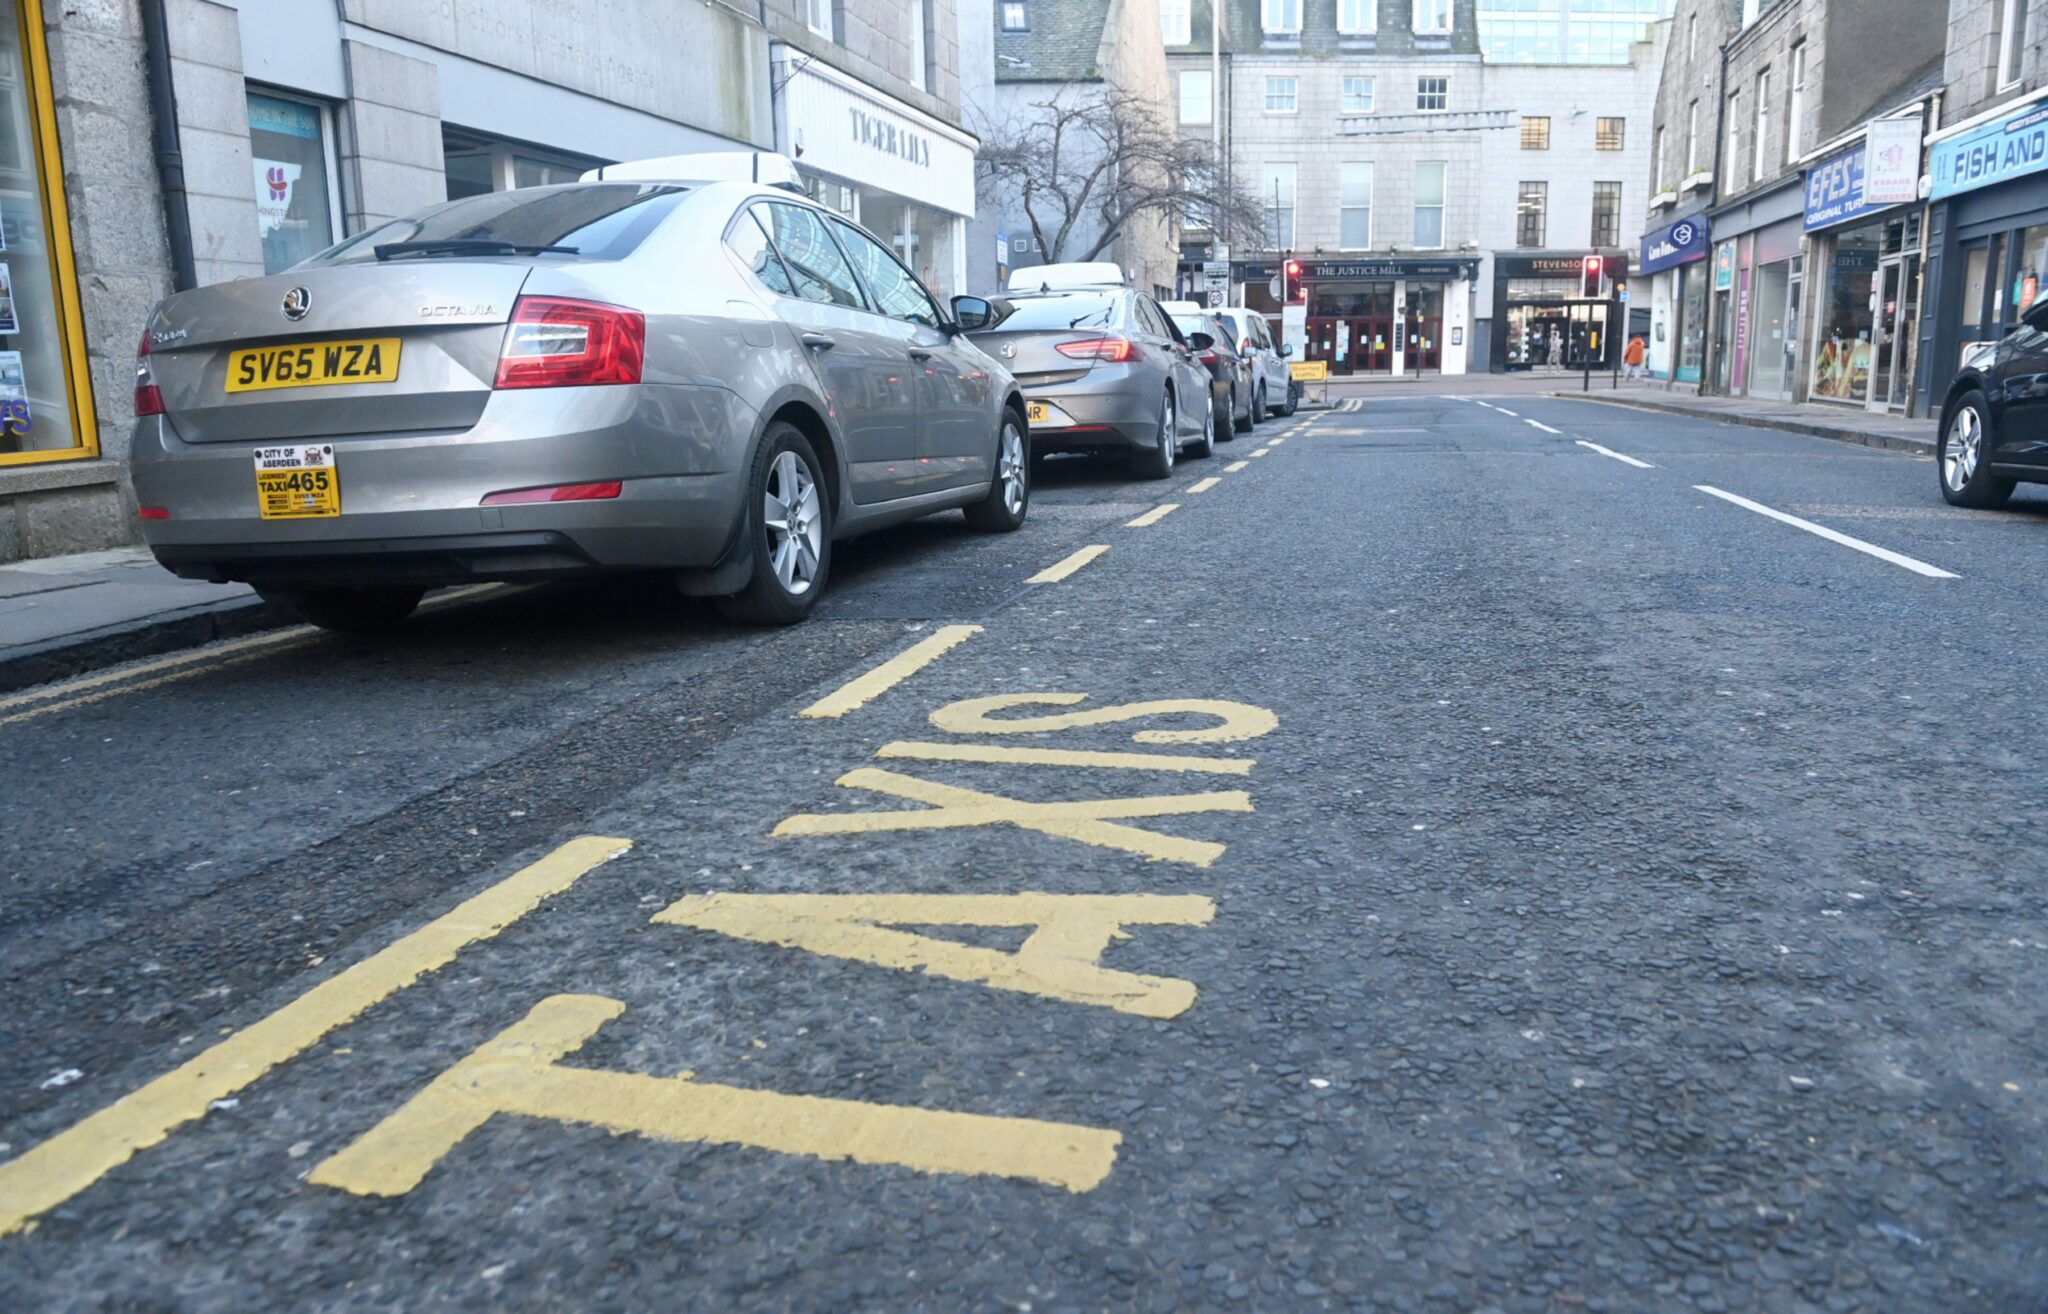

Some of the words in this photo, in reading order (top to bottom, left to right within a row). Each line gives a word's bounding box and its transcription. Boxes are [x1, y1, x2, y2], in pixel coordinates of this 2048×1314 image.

[848, 106, 898, 156] TIGER
[900, 129, 930, 168] LILY
[1953, 140, 1998, 185] FISH
[2003, 130, 2046, 169] AND
[1807, 155, 1854, 211] EFES
[1806, 205, 1843, 224] ORIGINAL
[1315, 266, 1336, 276] THE
[1338, 266, 1378, 276] JUSTICE
[1379, 266, 1405, 275] MILL
[1532, 260, 1583, 269] STEVENSO
[420, 304, 498, 318] OCTAVIA
[238, 348, 315, 385] SV65
[324, 344, 382, 378] WZA
[264, 448, 281, 459] CITY
[284, 447, 295, 457] OF
[263, 459, 302, 469] ABERDEEN
[259, 480, 288, 493] TAXI
[287, 471, 329, 493] 465
[306, 692, 1279, 1197] TAXIS
